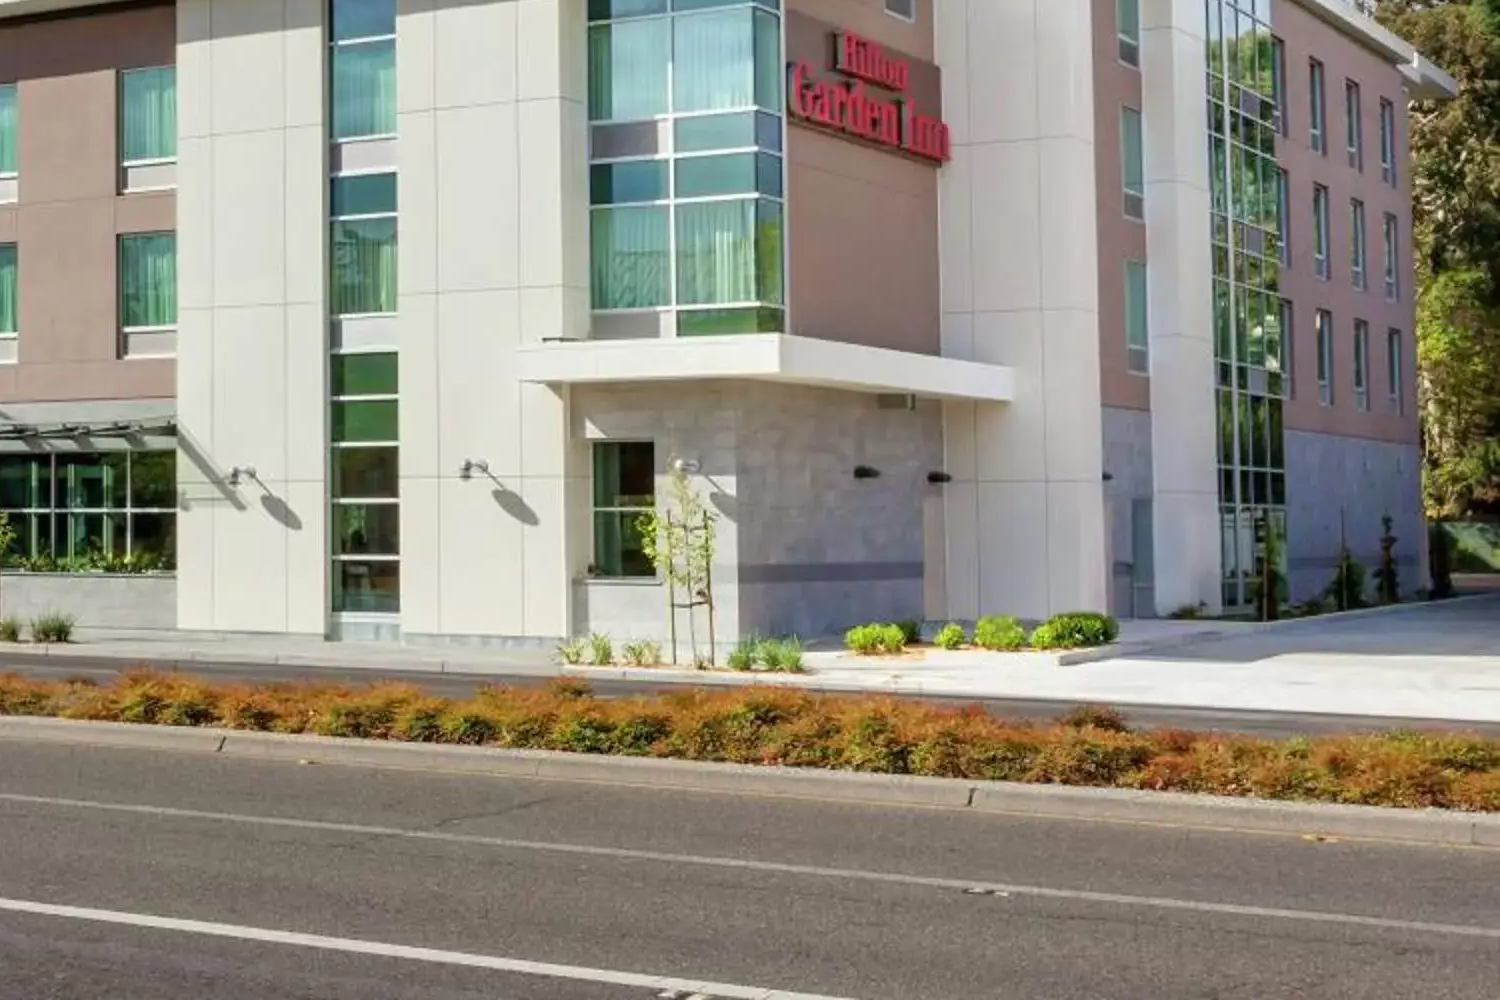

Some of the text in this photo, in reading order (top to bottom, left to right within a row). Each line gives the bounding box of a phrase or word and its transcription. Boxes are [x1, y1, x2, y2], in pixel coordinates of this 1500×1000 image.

[842, 29, 910, 90] Hilton
[792, 59, 951, 162] Garden Inn
